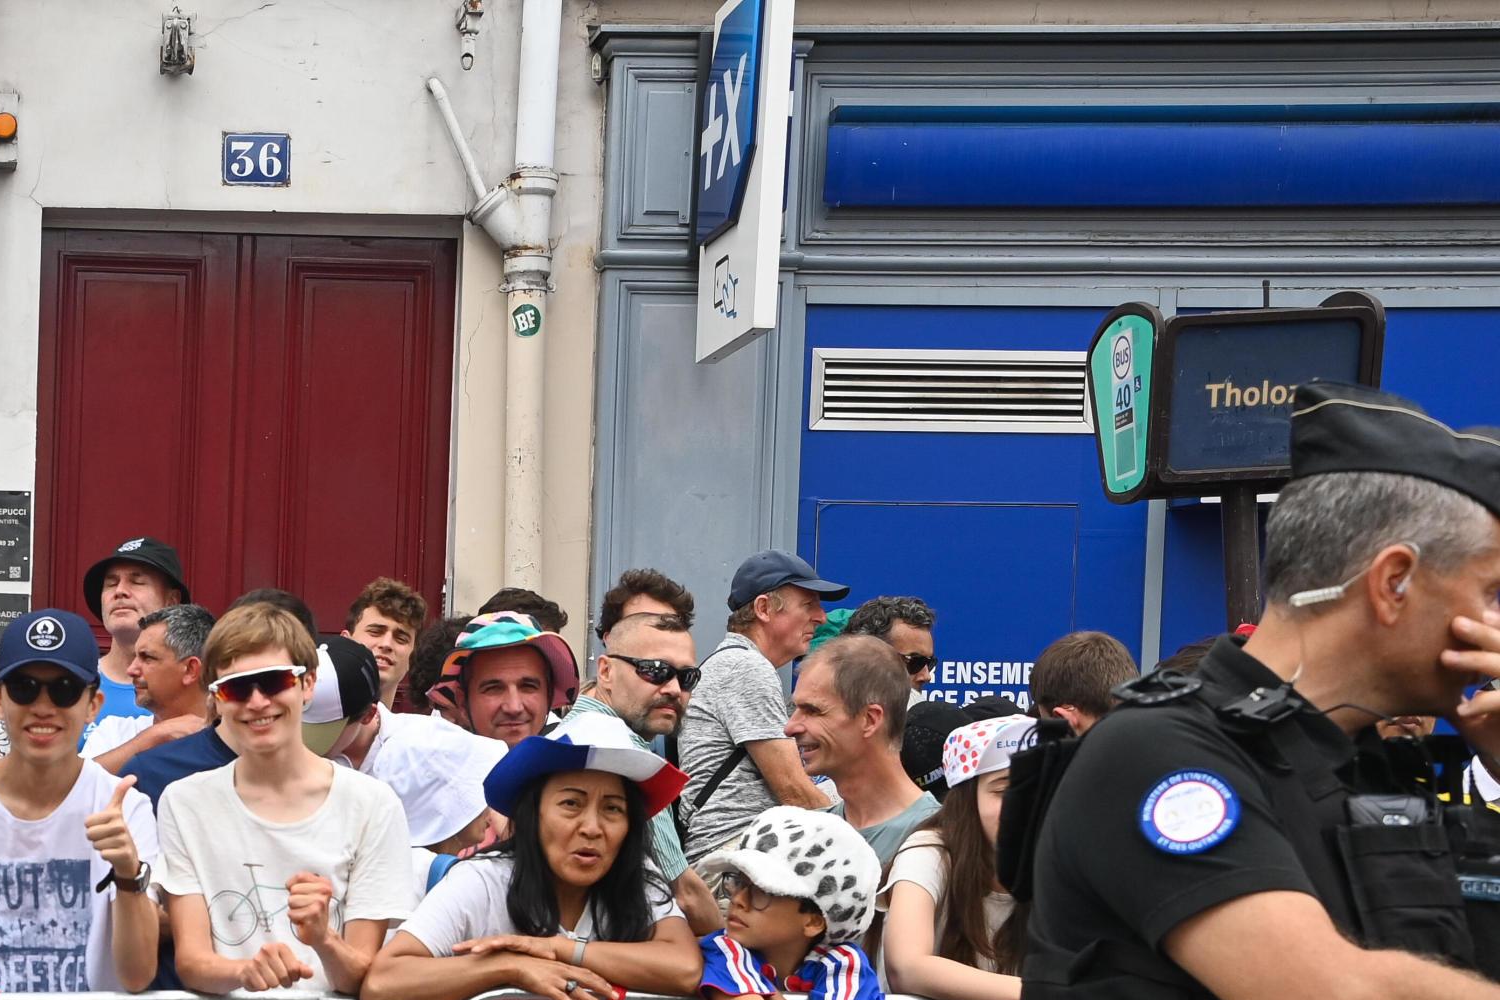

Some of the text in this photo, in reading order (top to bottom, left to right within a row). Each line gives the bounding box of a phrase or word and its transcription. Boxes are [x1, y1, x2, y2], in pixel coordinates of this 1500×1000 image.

[231, 141, 282, 178] 36
[1115, 347, 1129, 368] BUS
[1115, 383, 1131, 410] 40
